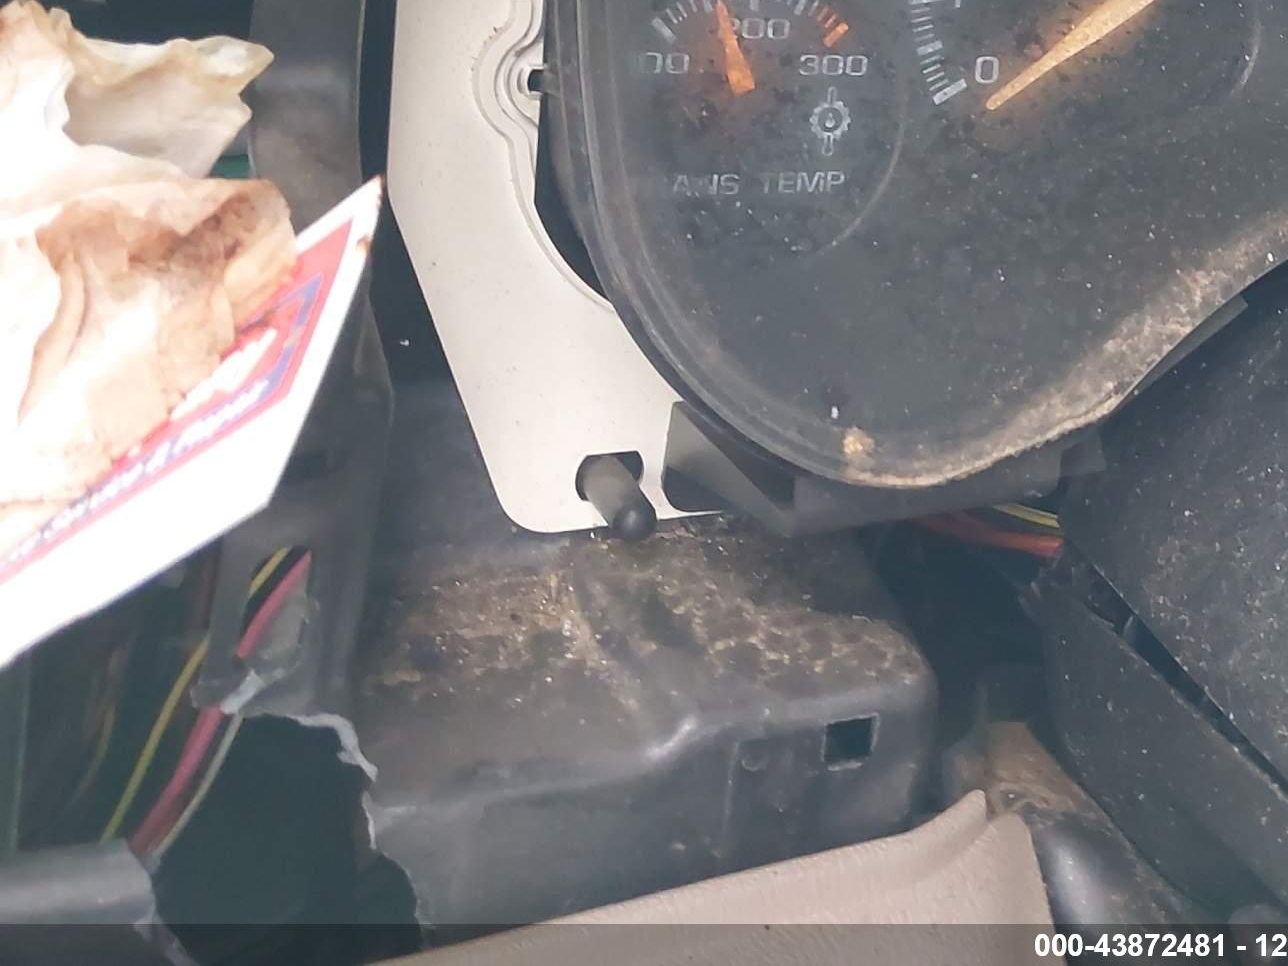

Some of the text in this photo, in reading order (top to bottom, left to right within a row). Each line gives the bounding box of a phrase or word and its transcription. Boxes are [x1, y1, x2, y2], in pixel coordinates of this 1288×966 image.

[799, 54, 868, 76] 300
[974, 55, 999, 85] 0
[762, 170, 846, 194] TEMP
